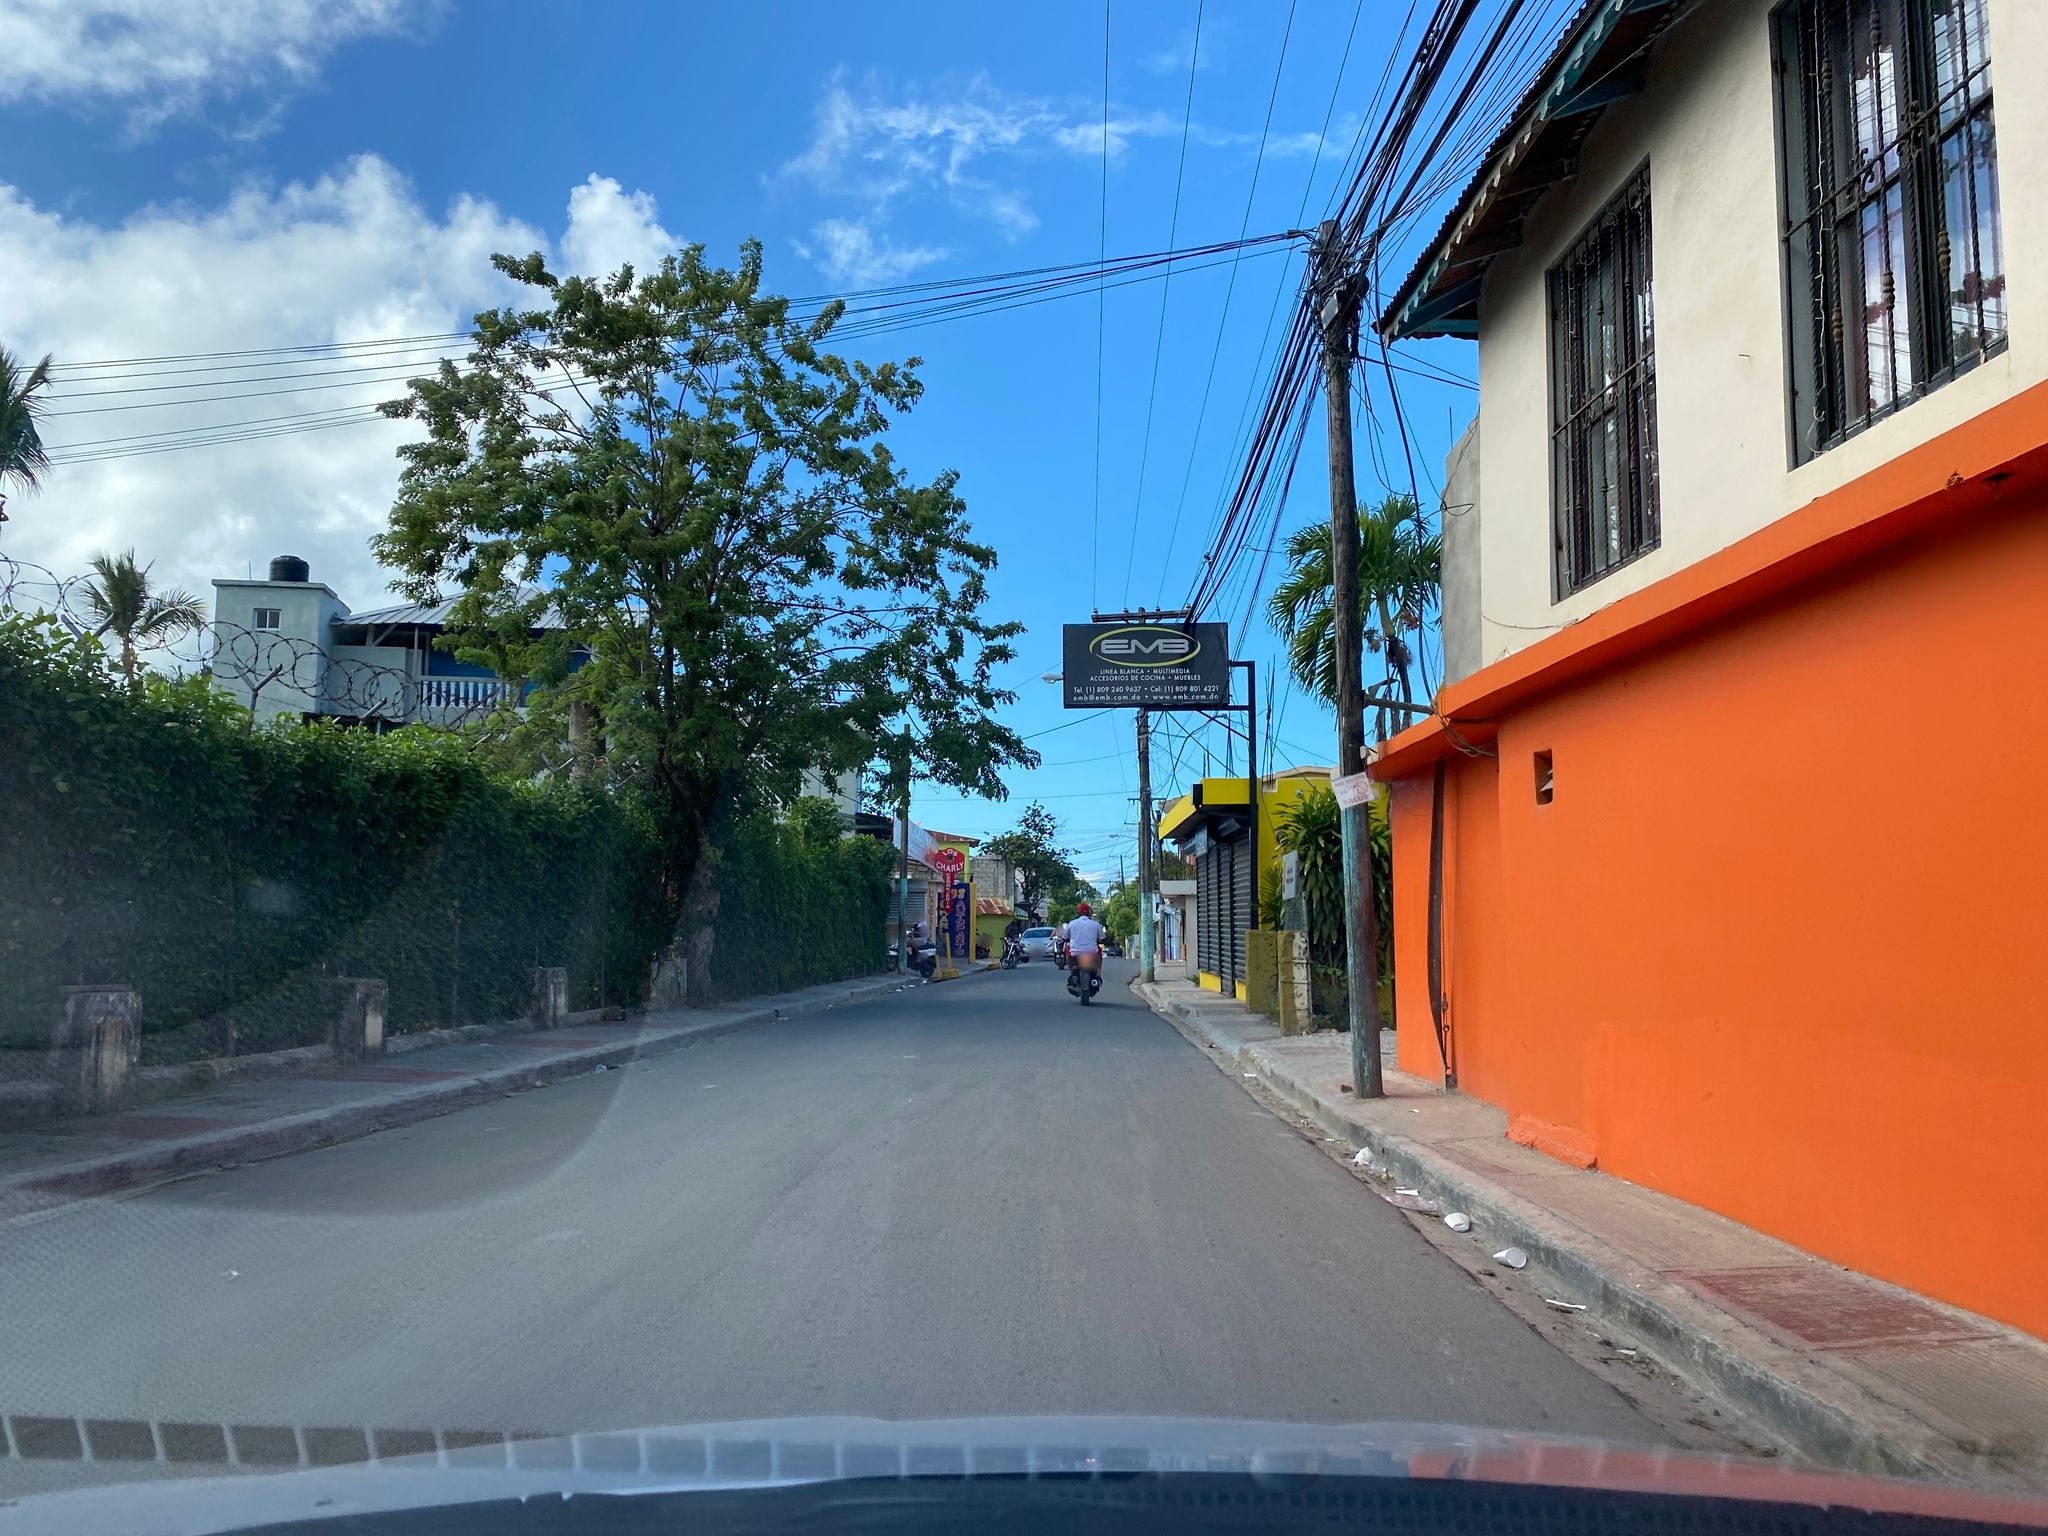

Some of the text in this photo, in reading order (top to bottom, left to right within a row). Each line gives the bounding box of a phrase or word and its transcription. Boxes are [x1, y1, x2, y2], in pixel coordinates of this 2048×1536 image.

[1100, 638, 1190, 654] EMB
[1085, 686, 1095, 694] (1)
[1125, 685, 1142, 693] 9637
[1164, 685, 1174, 693] (1)
[1073, 692, 1219, 701] emb@emb.com.do www.emb.com.do
[942, 848, 958, 857] LOS
[936, 861, 964, 872] CHARLY
